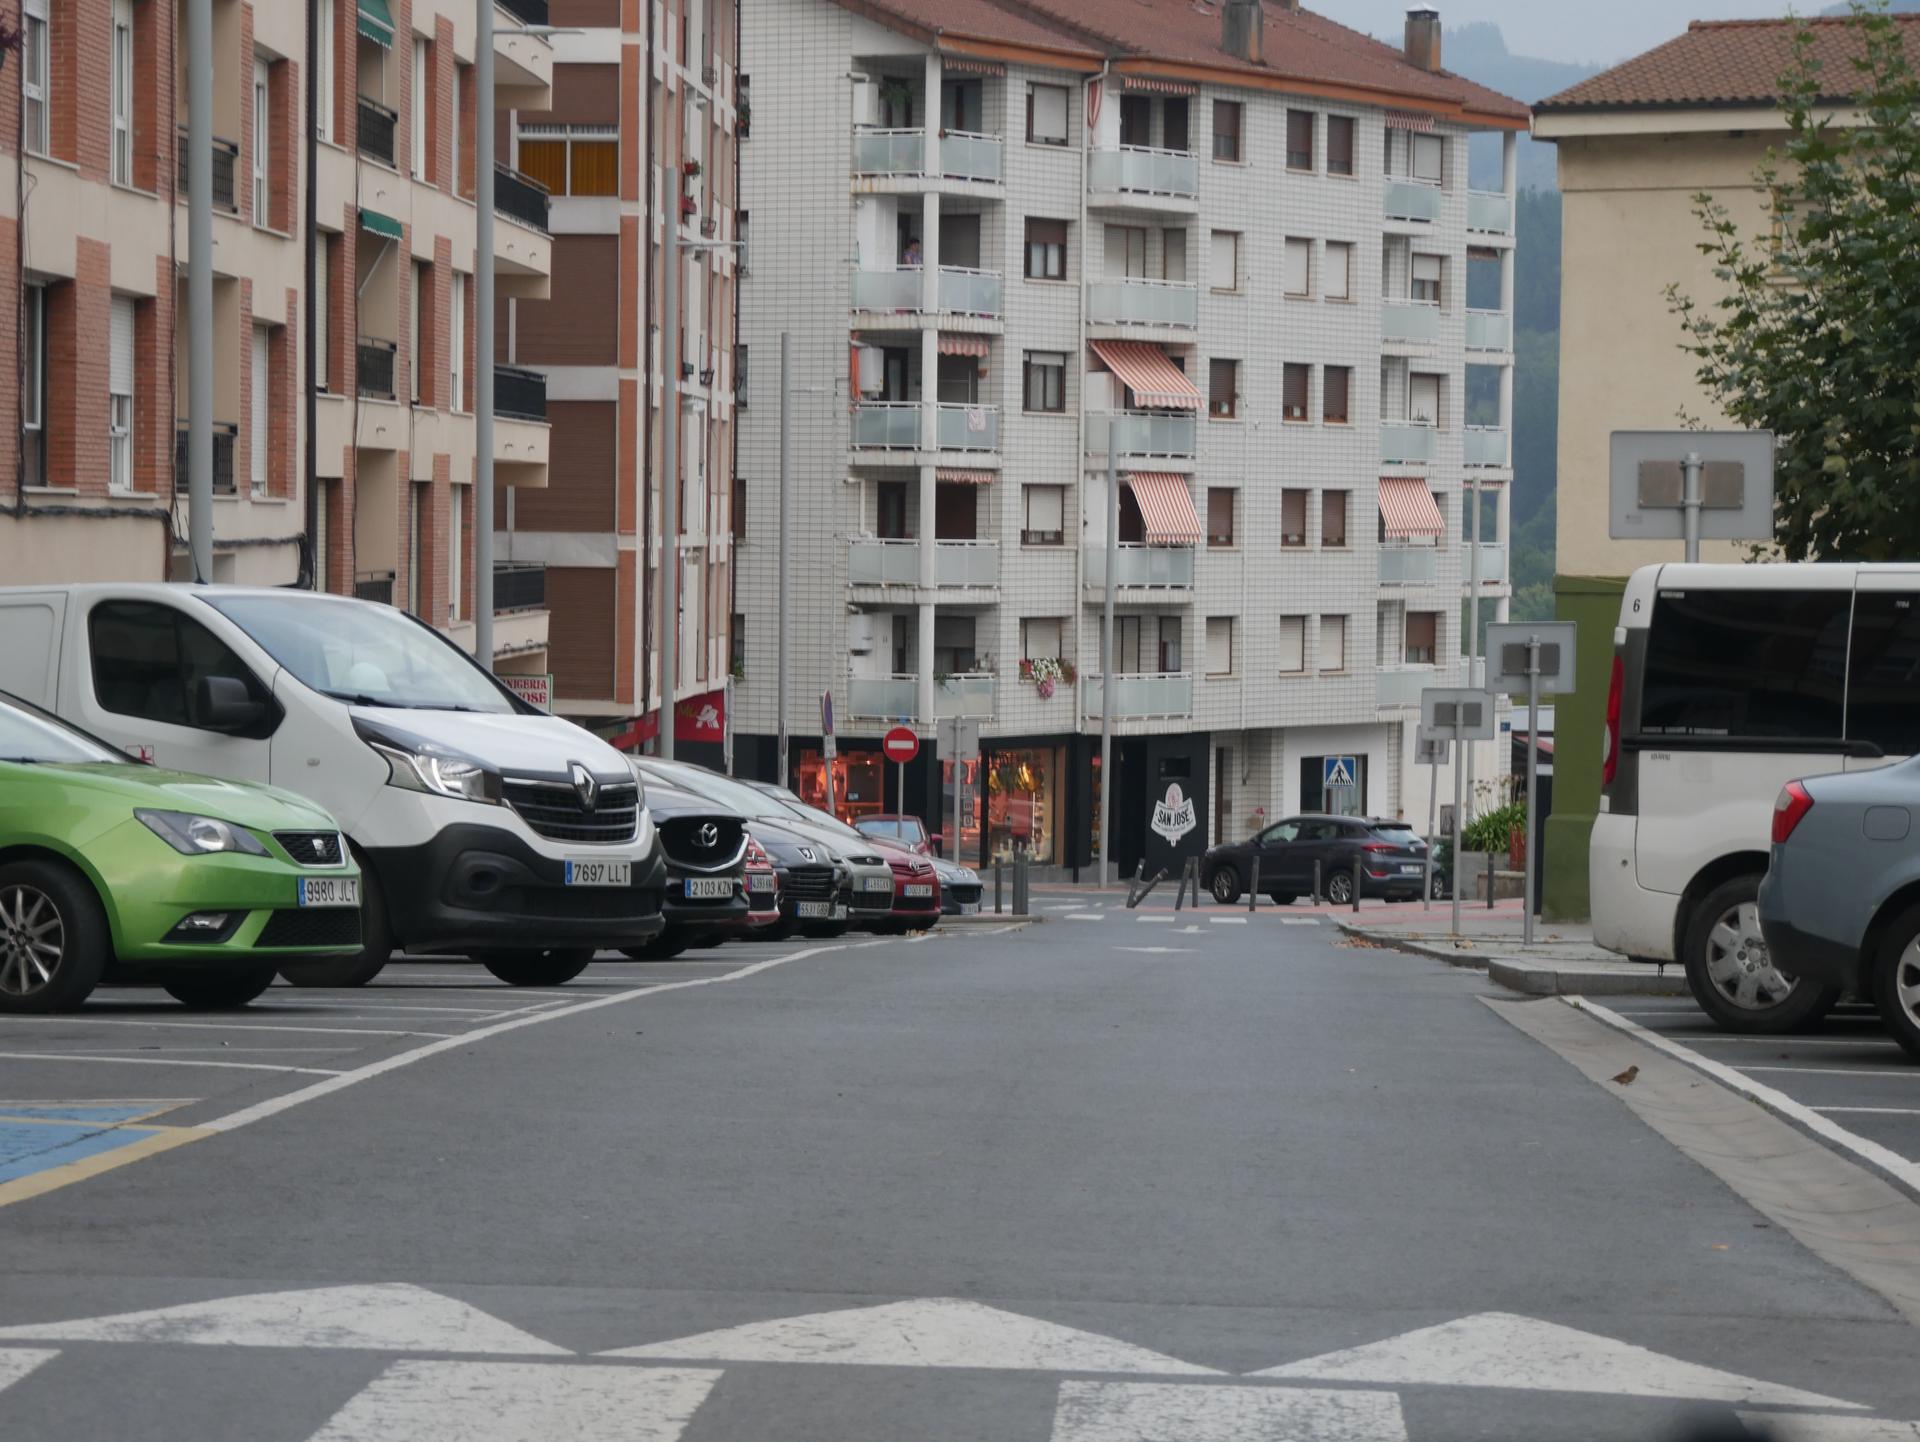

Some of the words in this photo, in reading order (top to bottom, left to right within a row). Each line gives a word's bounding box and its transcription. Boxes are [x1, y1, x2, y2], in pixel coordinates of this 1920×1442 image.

[1633, 598, 1641, 613] 6
[519, 692, 547, 704] OSE
[1157, 809, 1171, 826] SAN
[1172, 807, 1189, 827] JOSE
[574, 864, 604, 882] 7697
[608, 864, 629, 883] LLT
[307, 881, 334, 902] 9980
[338, 880, 356, 902] JLT
[692, 881, 715, 896] 2103
[717, 880, 732, 895] KZN
